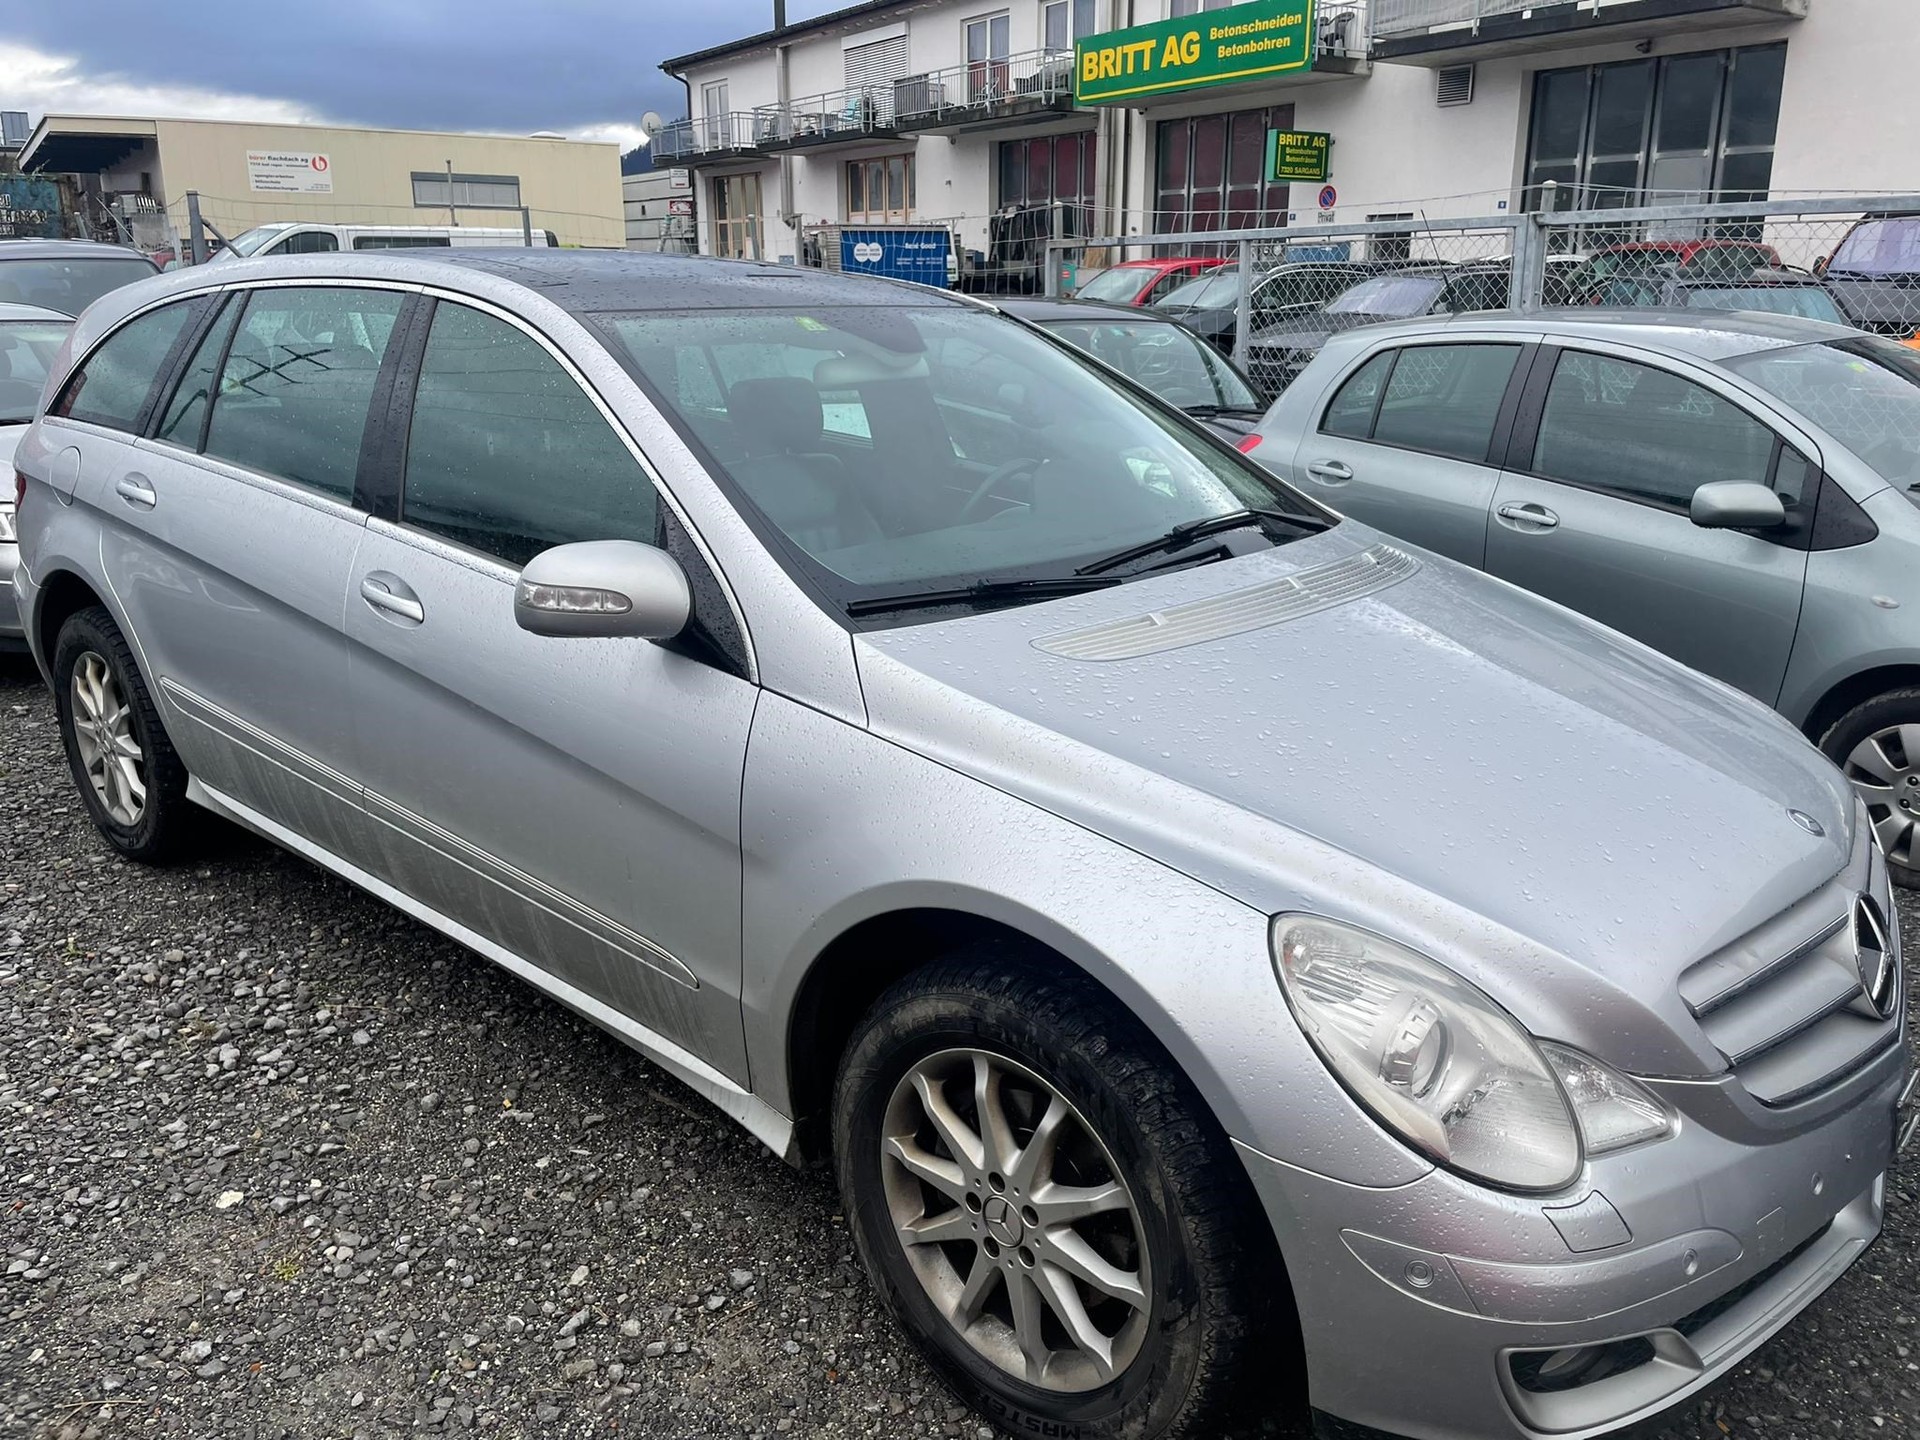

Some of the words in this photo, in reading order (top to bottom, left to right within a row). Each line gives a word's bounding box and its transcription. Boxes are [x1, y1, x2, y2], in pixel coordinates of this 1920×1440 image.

[1210, 13, 1302, 40] Betonschneiden
[1083, 39, 1156, 82] BRITT
[1160, 31, 1201, 69] AG
[1218, 35, 1291, 58] Betonbohren
[1279, 133, 1309, 147] BRITT
[1312, 136, 1326, 148] AG
[1294, 166, 1321, 175] SARGANS
